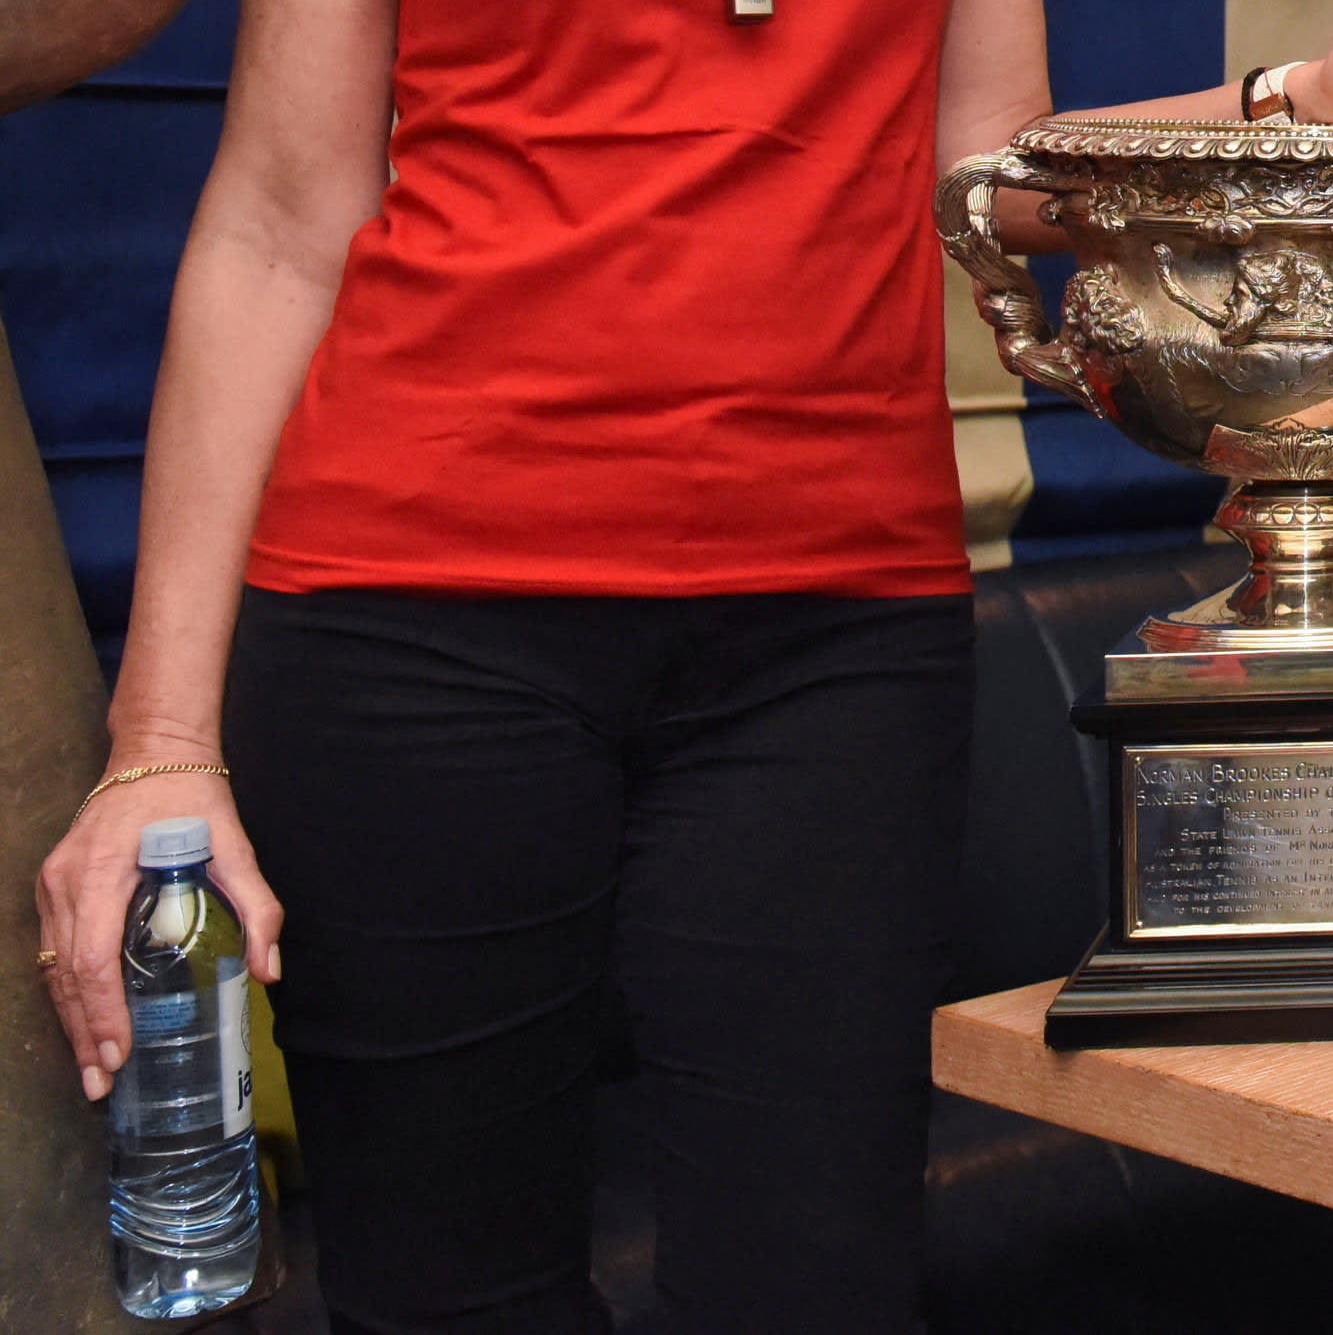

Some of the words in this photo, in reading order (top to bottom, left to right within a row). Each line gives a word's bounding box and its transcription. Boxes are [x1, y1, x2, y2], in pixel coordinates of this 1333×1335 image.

[1137, 767, 1204, 784] NORMAN
[1212, 763, 1290, 783] BROOKES
[1136, 790, 1198, 806] SINGLES
[1205, 786, 1319, 804] CHAMPIONSHIP
[1180, 828, 1217, 842] STATE
